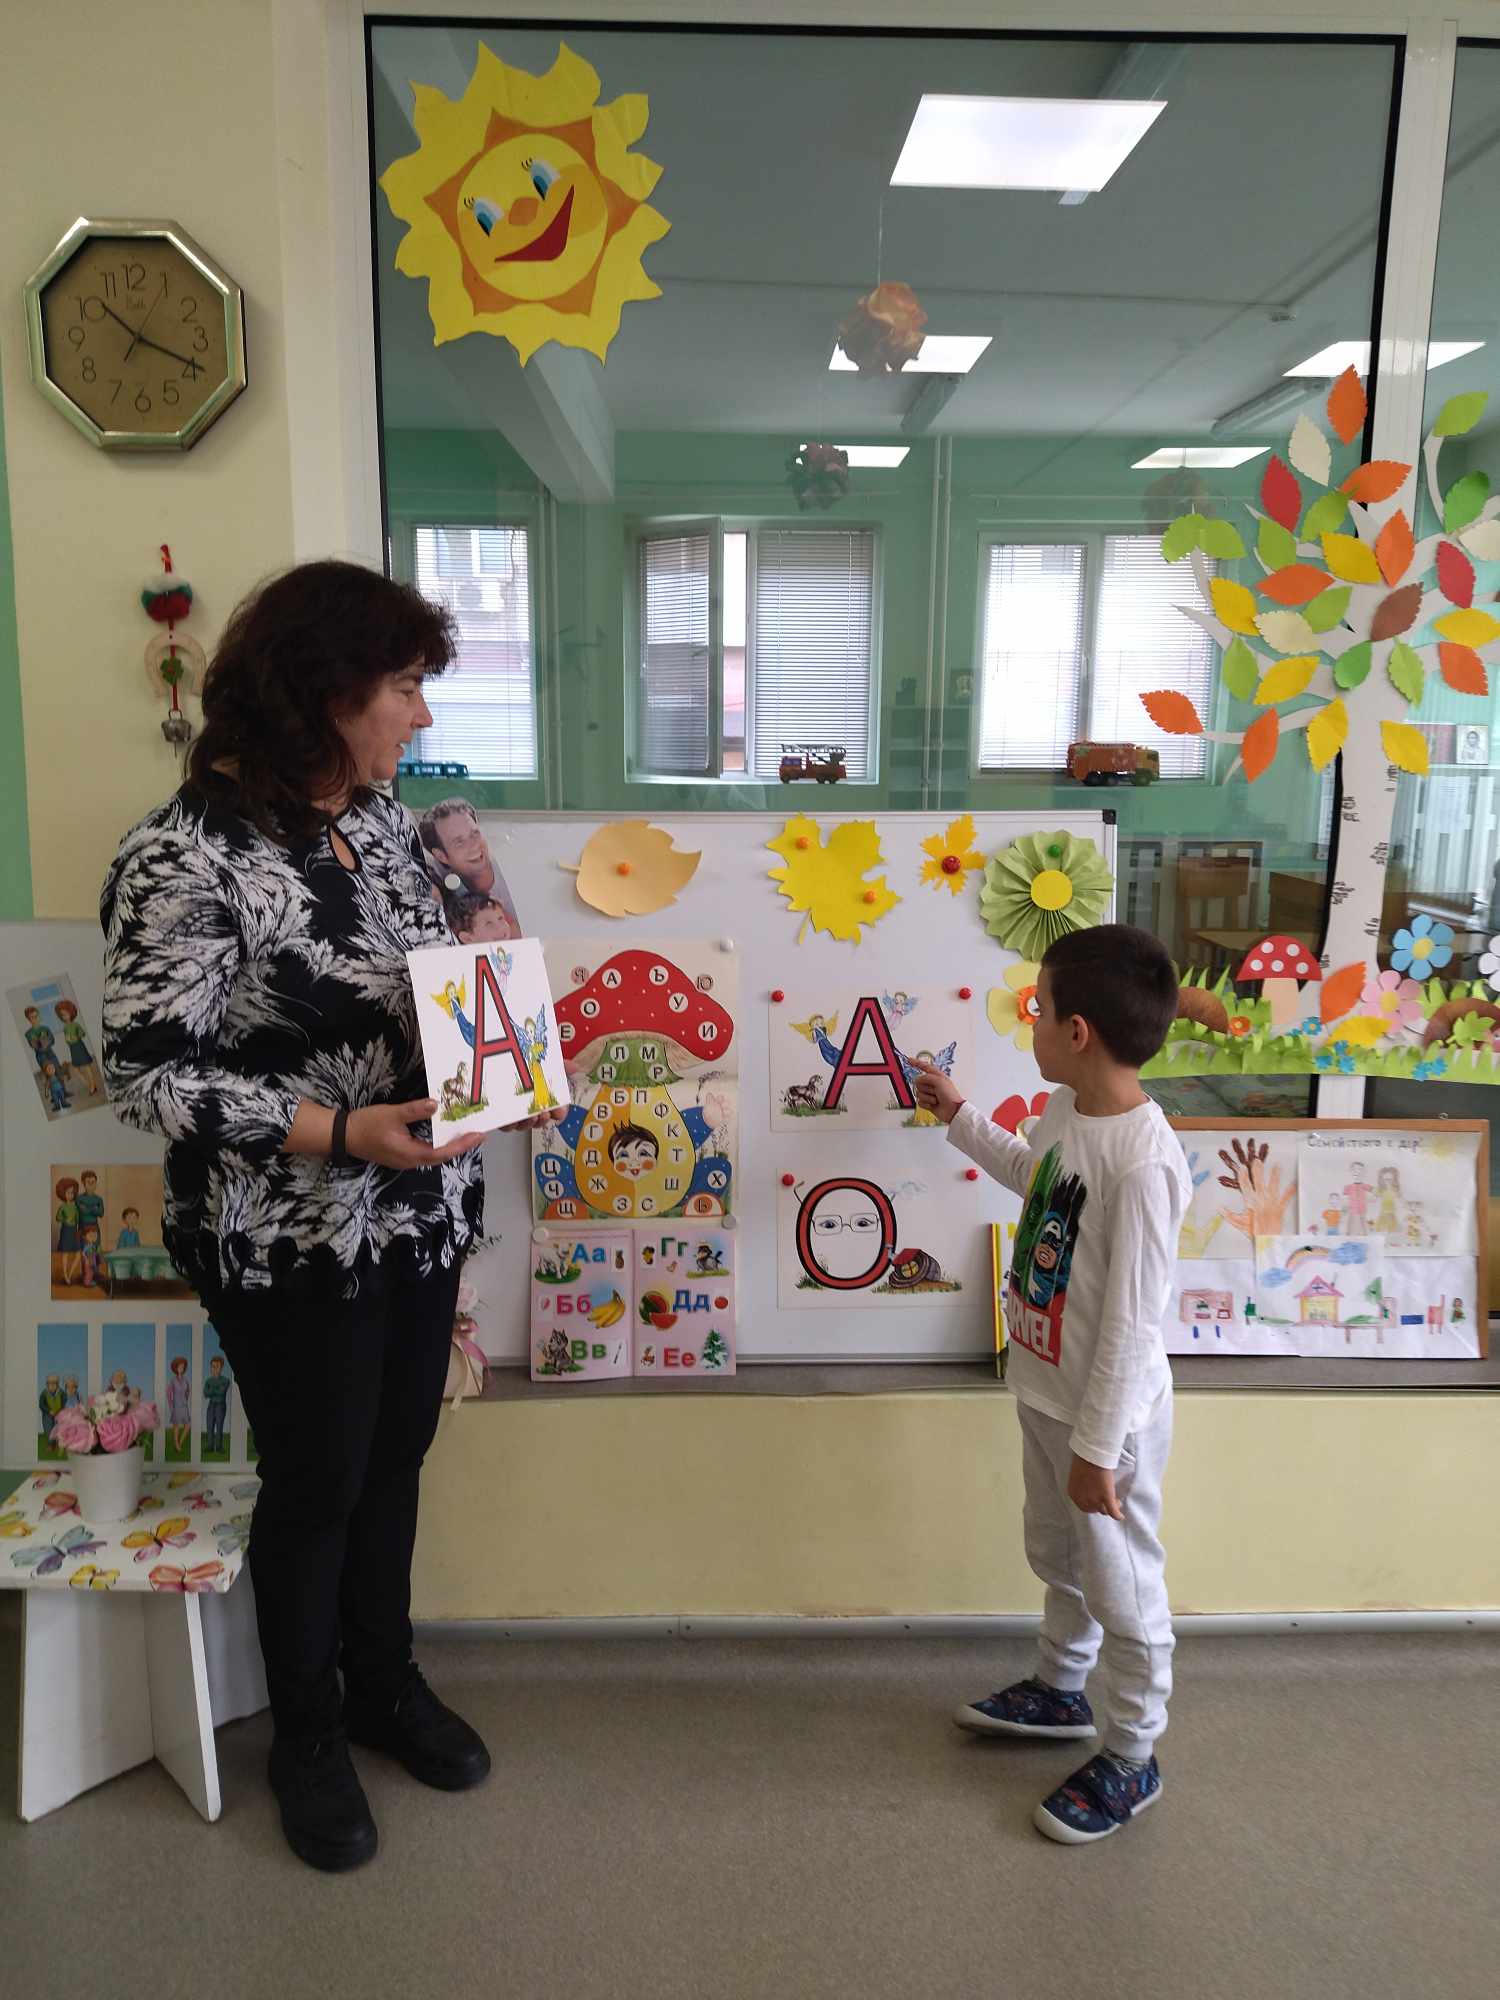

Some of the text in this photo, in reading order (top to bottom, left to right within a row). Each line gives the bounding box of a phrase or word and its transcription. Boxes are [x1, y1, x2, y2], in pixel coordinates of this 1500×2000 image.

[122, 263, 146, 290] 12
[101, 272, 116, 296] 11
[161, 272, 167, 296] 1
[75, 296, 106, 321] 10
[181, 296, 197, 323] 2
[68, 327, 85, 352] 9
[193, 327, 208, 352] 3
[82, 356, 96, 383] 8
[182, 357, 197, 381] 4
[108, 379, 122, 405] 7
[163, 380, 179, 405] 5
[135, 387, 151, 412] 6
[606, 972, 618, 984] А
[654, 968, 665, 982] Ъ
[584, 1002, 596, 1014] О
[673, 996, 684, 1009] У
[470, 955, 534, 1104] А
[561, 1026, 571, 1038] Е
[702, 1024, 714, 1036] И
[614, 1048, 626, 1059] Л
[642, 1047, 654, 1059] М
[821, 997, 916, 1109] А
[602, 1067, 612, 1078] Н
[654, 1066, 663, 1078] Р
[614, 1091, 624, 1104] Б
[636, 1090, 647, 1103] П
[598, 1106, 608, 1118] В
[655, 1103, 668, 1118] Ф
[590, 1126, 599, 1137] Г
[668, 1125, 678, 1136] К
[586, 1151, 598, 1164] Д
[673, 1149, 682, 1160] Т
[545, 1160, 558, 1174] Ц
[591, 1178, 606, 1190] Ж
[666, 1178, 678, 1190] Ш
[712, 1173, 722, 1185] Х
[548, 1184, 559, 1195] Ч
[560, 1202, 574, 1216] Щ
[617, 1198, 626, 1210] З
[642, 1199, 653, 1210] С
[796, 1177, 897, 1290] О
[571, 1243, 606, 1264] Аа
[661, 1237, 689, 1257] Гг
[556, 1293, 592, 1315] Бб
[672, 1289, 710, 1312] Дд
[571, 1340, 607, 1360] Вв
[663, 1348, 696, 1367] Ее
